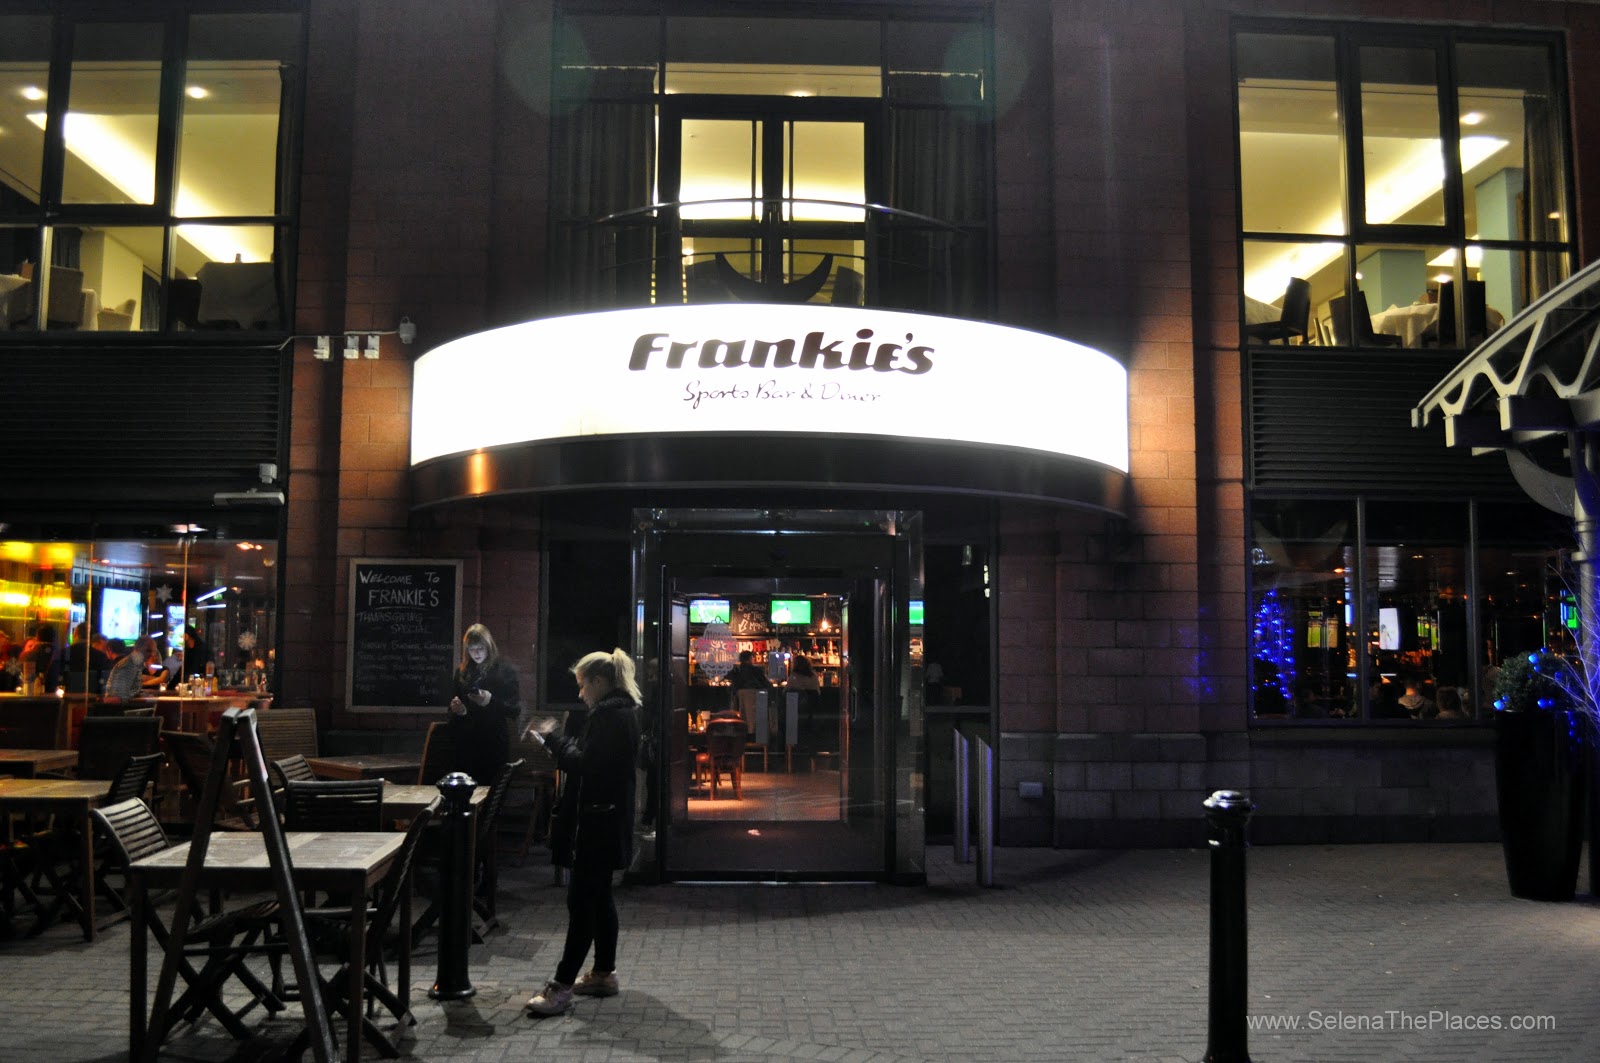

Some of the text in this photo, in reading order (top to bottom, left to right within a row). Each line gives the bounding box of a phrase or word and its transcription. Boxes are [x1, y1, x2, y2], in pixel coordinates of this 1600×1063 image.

[683, 379, 882, 409] Sports Bar & Diner
[368, 587, 439, 608] FRANKIE'S
